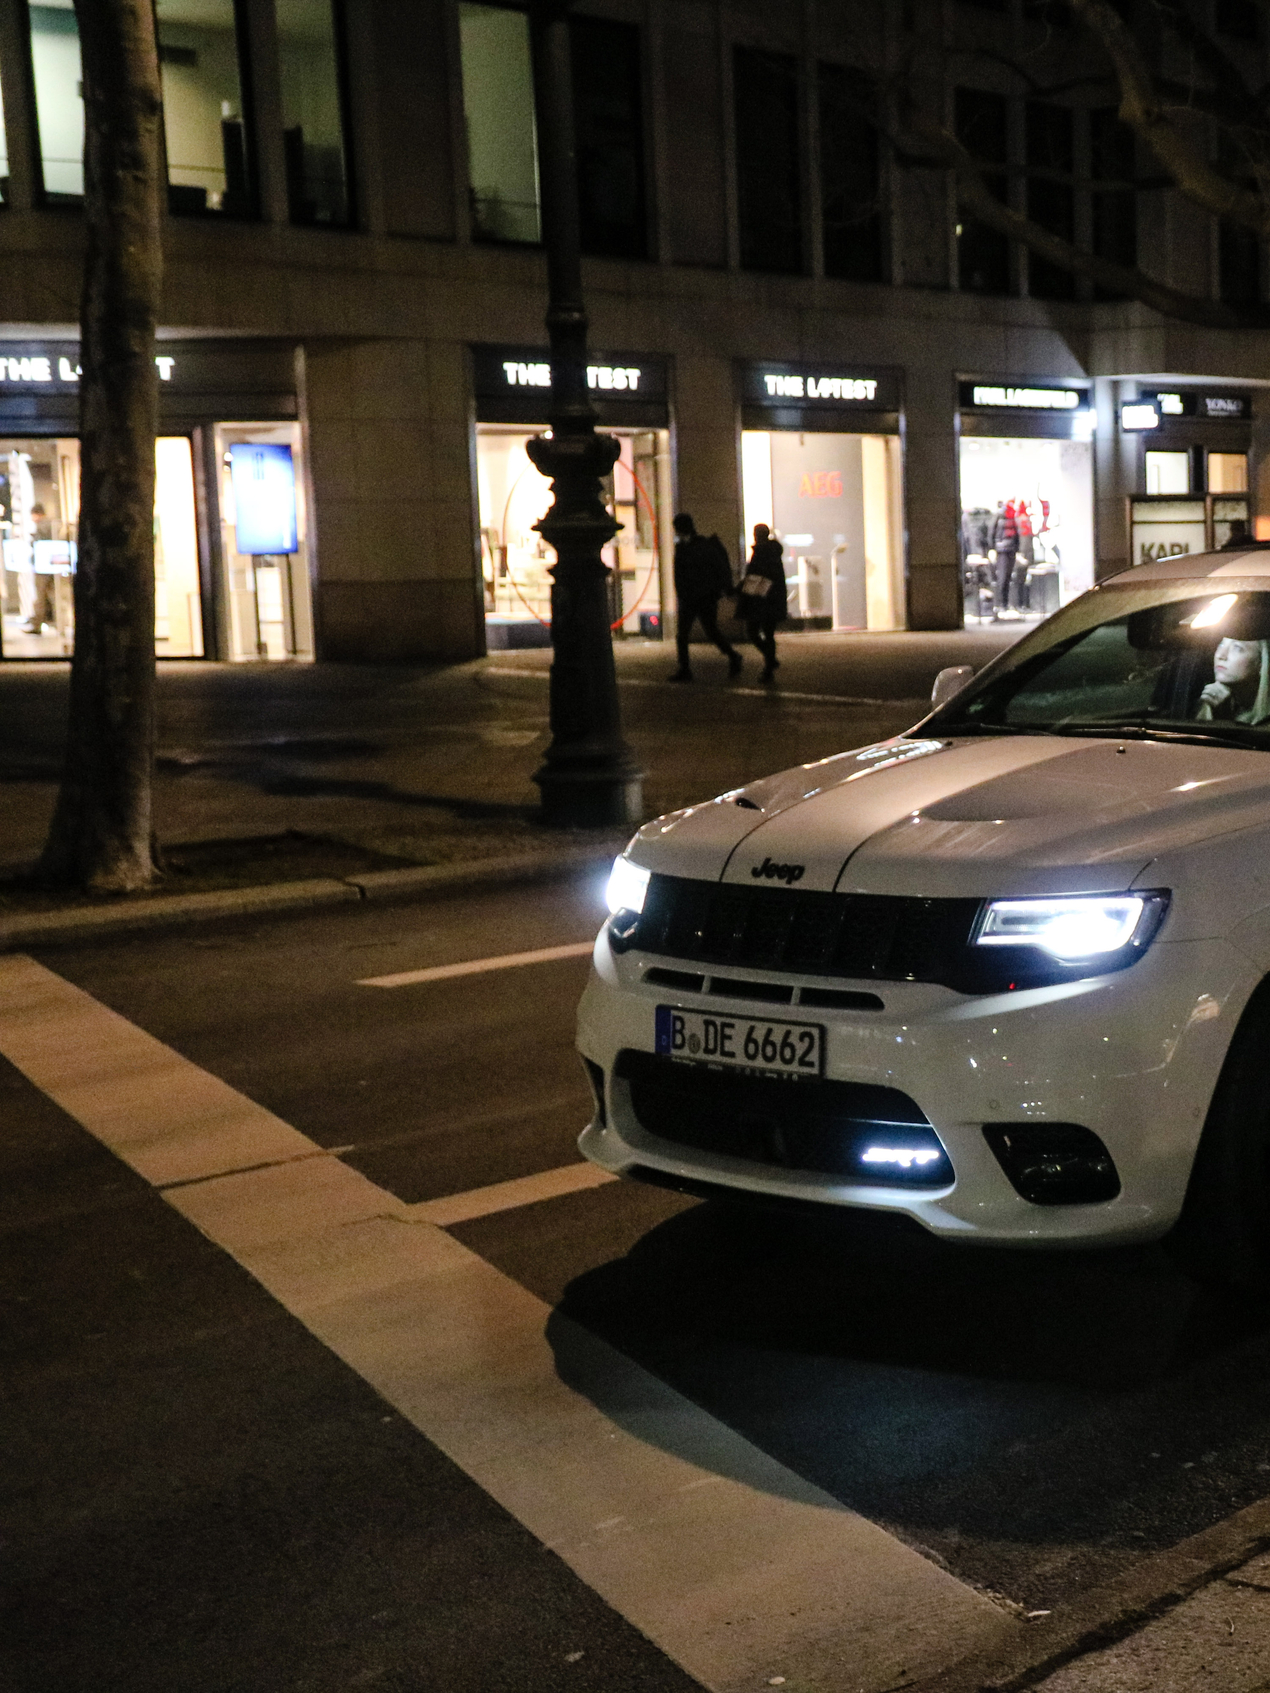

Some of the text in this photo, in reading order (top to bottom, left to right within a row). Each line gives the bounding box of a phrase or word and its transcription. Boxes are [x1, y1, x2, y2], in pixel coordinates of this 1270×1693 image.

[503, 361, 641, 391] THE TEST
[764, 374, 877, 400] THE LATEST
[797, 470, 843, 499] AEG
[750, 856, 806, 885] Jeep
[672, 1015, 816, 1069] B DE 6662
